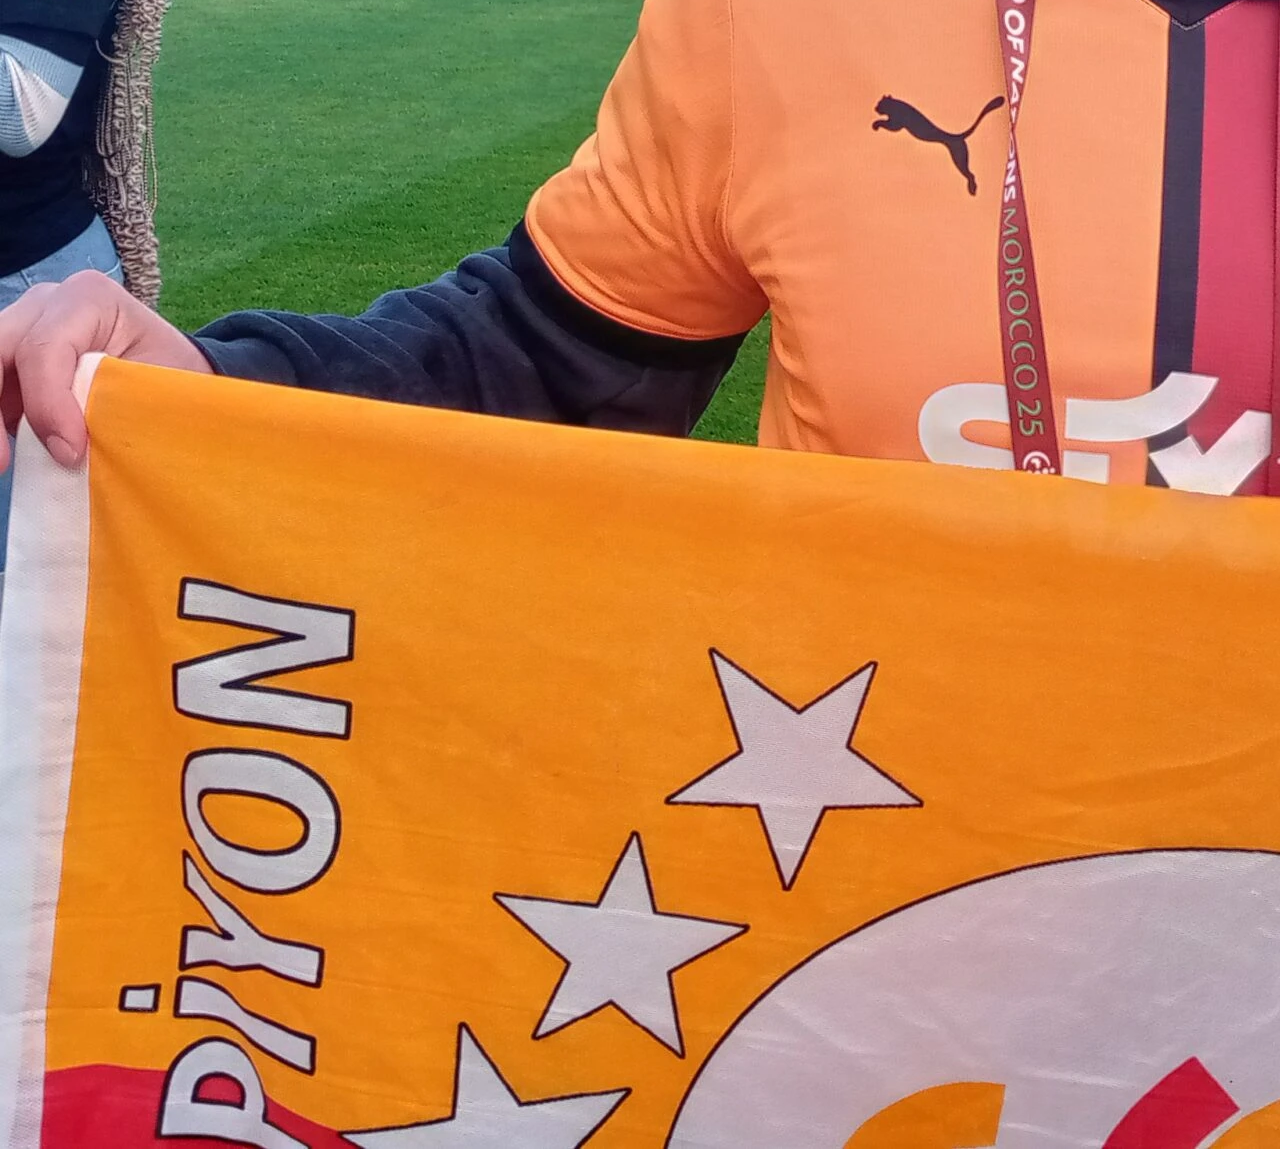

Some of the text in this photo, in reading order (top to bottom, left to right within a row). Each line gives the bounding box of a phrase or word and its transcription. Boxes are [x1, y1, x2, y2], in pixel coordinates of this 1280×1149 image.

[1004, 8, 1025, 54] OF
[1001, 205, 1038, 391] MOROCCO
[1017, 399, 1044, 437] 25
